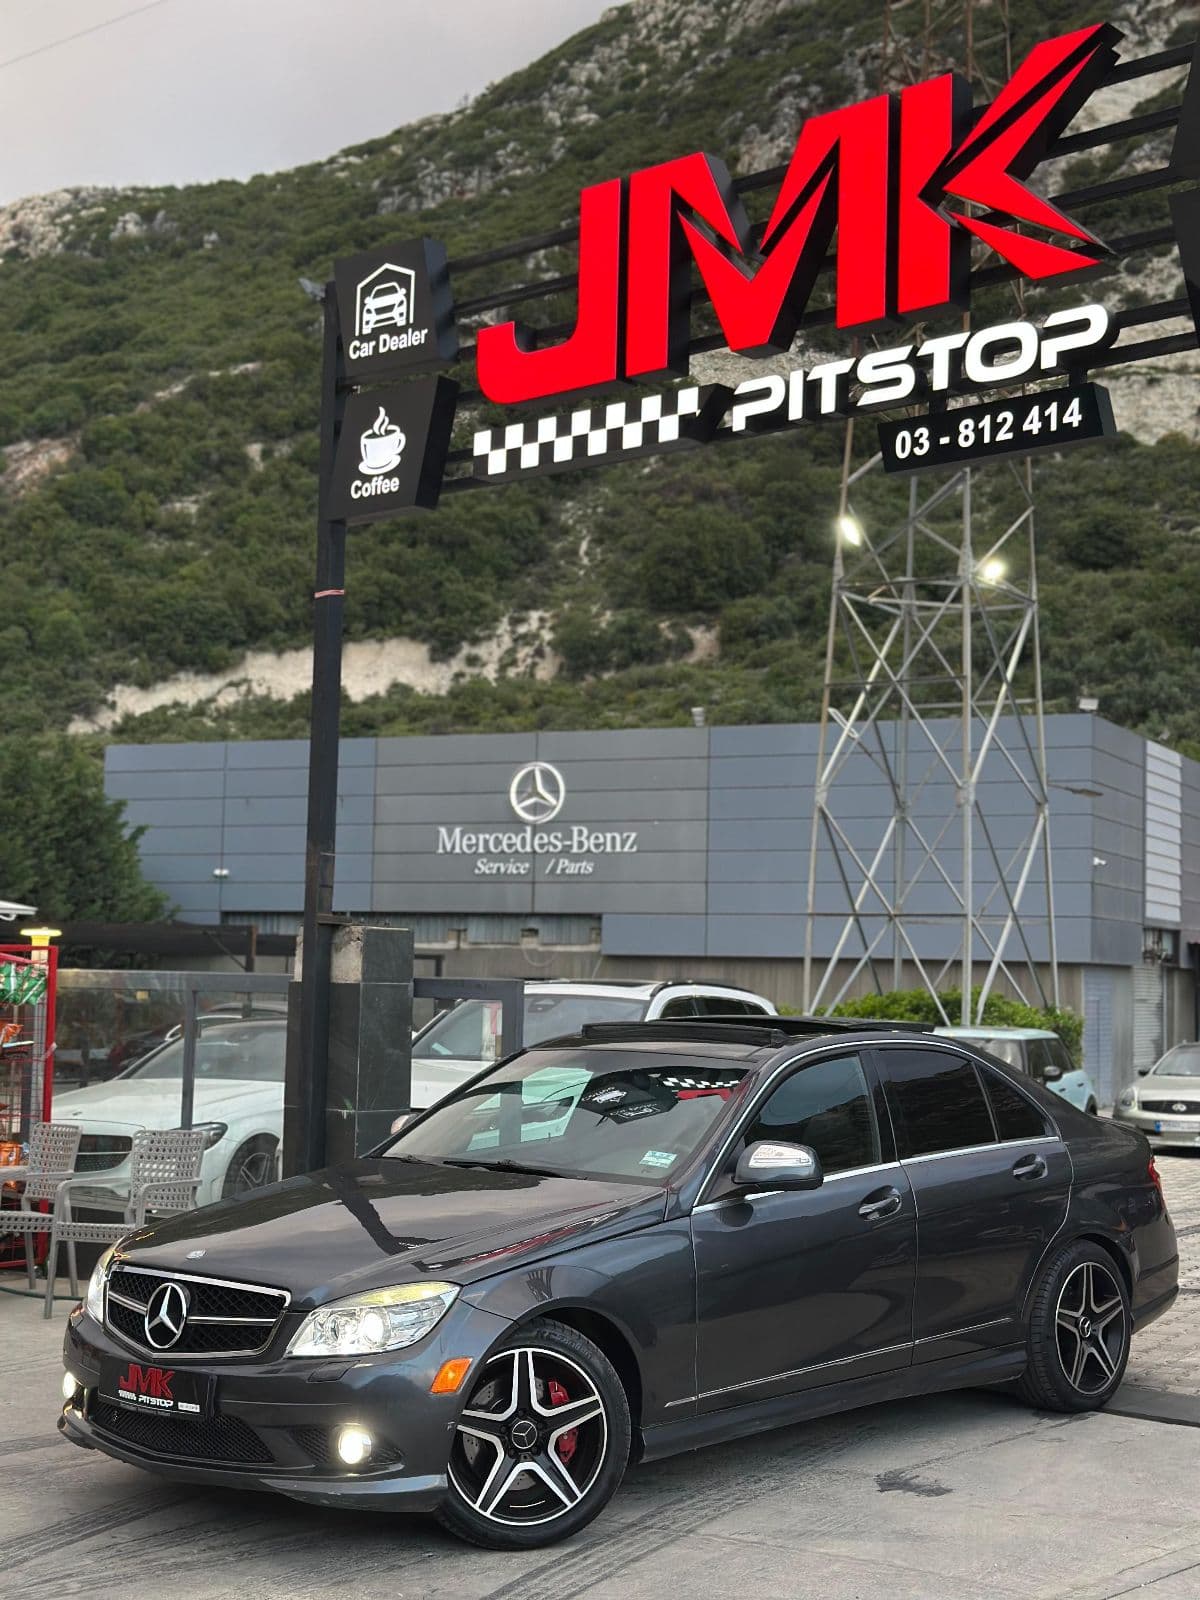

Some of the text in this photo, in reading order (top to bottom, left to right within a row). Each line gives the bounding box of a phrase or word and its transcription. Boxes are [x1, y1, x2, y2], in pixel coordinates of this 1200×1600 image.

[476, 23, 1110, 405] JMK
[348, 327, 429, 360] Car Dealer
[731, 303, 1109, 432] PITSTOP
[894, 426, 930, 459] 03
[957, 410, 1014, 448] 812
[1022, 397, 1083, 436] 414
[350, 474, 400, 500] Coffee
[436, 825, 638, 854] Mercedes-Benz
[474, 857, 530, 875] Service
[555, 857, 595, 875] Parts
[118, 1363, 175, 1399] JMK
[138, 1394, 174, 1408] PITSTOP
